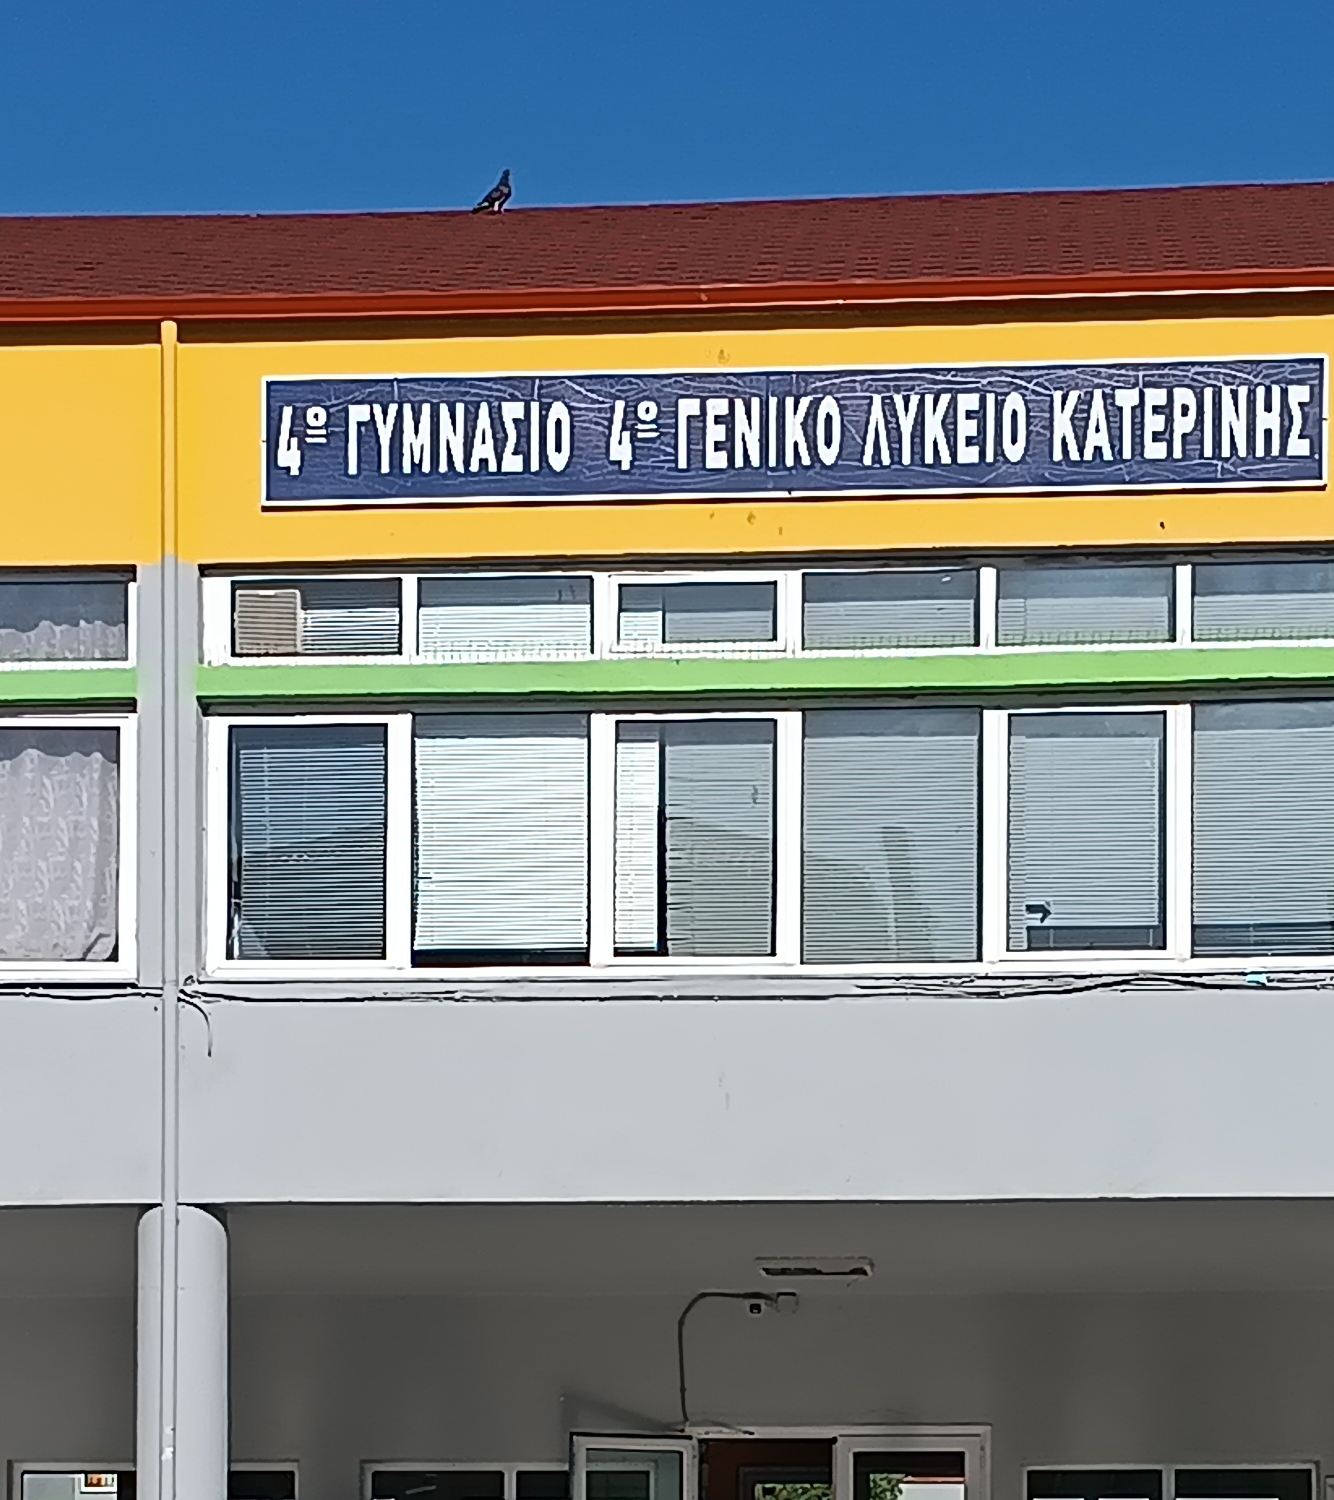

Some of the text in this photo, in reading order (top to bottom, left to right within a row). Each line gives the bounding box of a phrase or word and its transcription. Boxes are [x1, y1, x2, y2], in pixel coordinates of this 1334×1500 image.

[347, 400, 571, 475] ΓΥΜΝΑΣΙΟ
[677, 395, 841, 470] ΓΕΝΙΚΟ
[862, 390, 1027, 466] ΛΥΚΕΙΟ
[1052, 384, 1311, 463] ΚΑΤΕΡΙΝΗΣ
